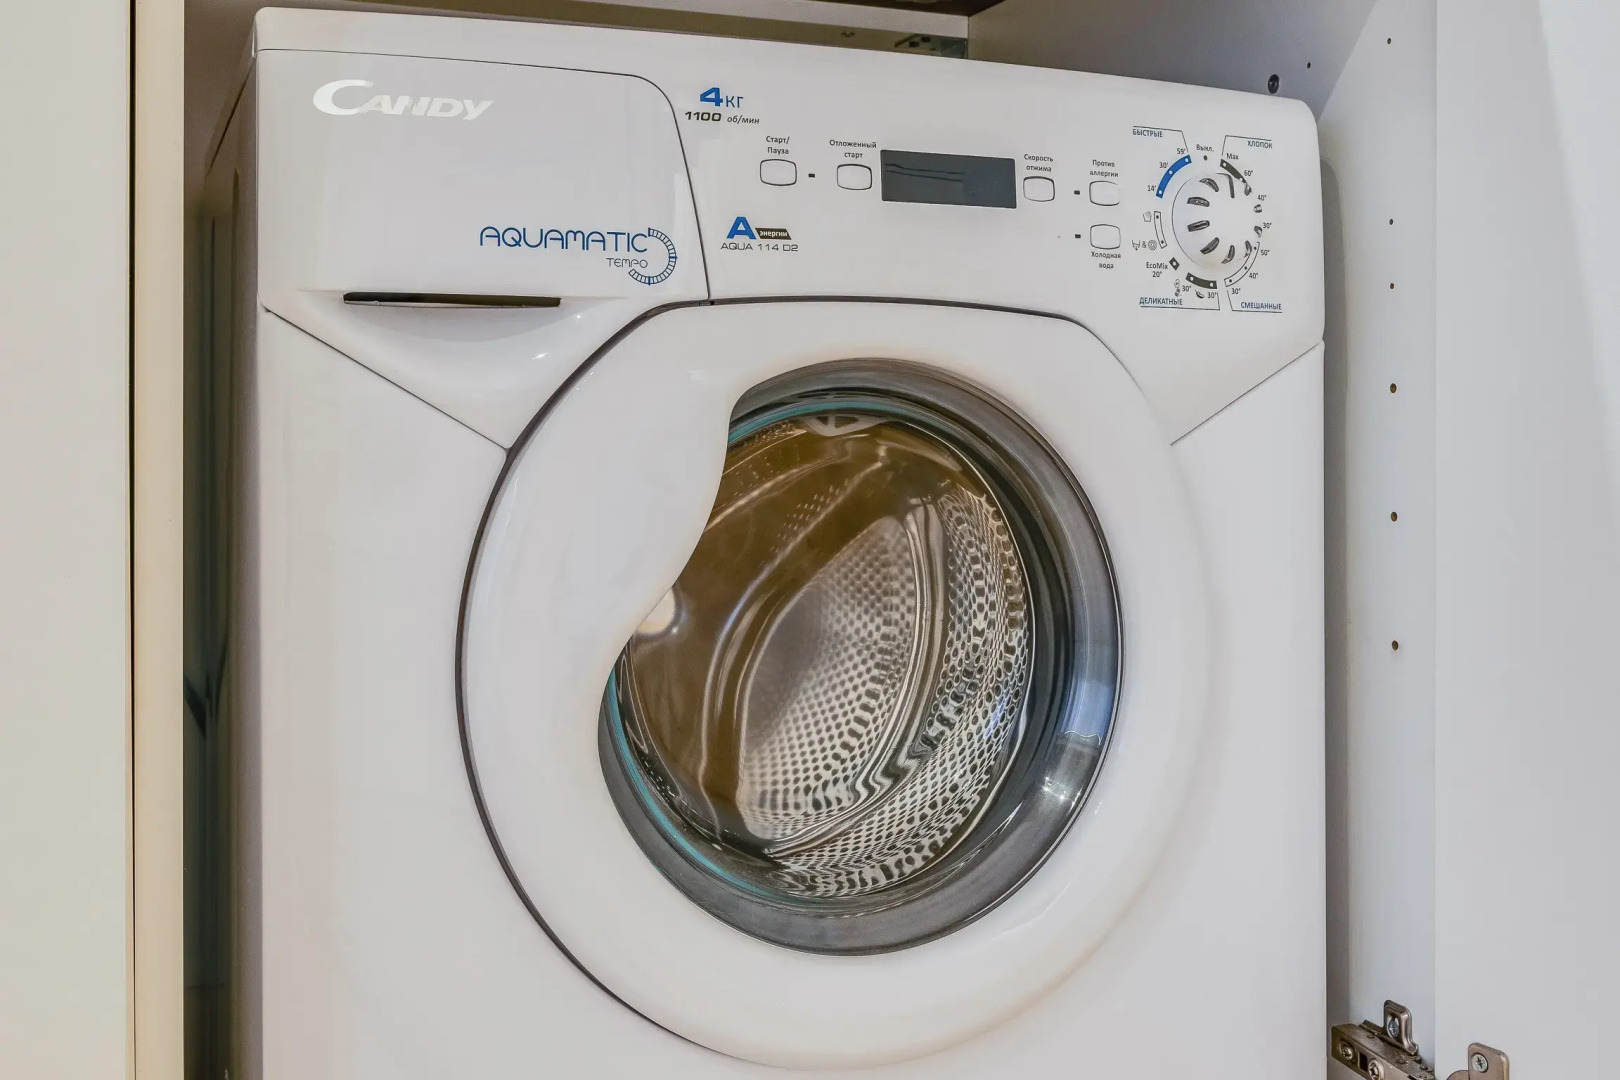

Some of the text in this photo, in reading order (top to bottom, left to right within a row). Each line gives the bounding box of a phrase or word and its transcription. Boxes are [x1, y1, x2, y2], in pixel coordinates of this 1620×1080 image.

[312, 79, 493, 121] CANDY
[685, 111, 760, 124] 1100 об/мин
[1132, 128, 1163, 138] БЫСТРЫЕ
[766, 135, 790, 145] Старт/
[829, 139, 877, 149] Отложенный
[1247, 140, 1273, 149] ХЛОПОК
[767, 147, 789, 155] Пауза
[1024, 153, 1054, 162] Скорость
[1092, 159, 1115, 168] Против
[1089, 169, 1119, 178] аллергии
[759, 227, 788, 238] энергии
[480, 226, 648, 254] AQUAMATIC
[720, 242, 753, 250] AQUA
[758, 243, 779, 251] 114
[1091, 251, 1121, 260] Холодная
[606, 257, 648, 269] TEMPO
[1099, 262, 1114, 270] вода
[1146, 261, 1168, 270] EcoMix
[1139, 297, 1183, 306] ДЕЛИКАТНЫЕ
[1241, 301, 1282, 311] СМЕШАННЫЕ
